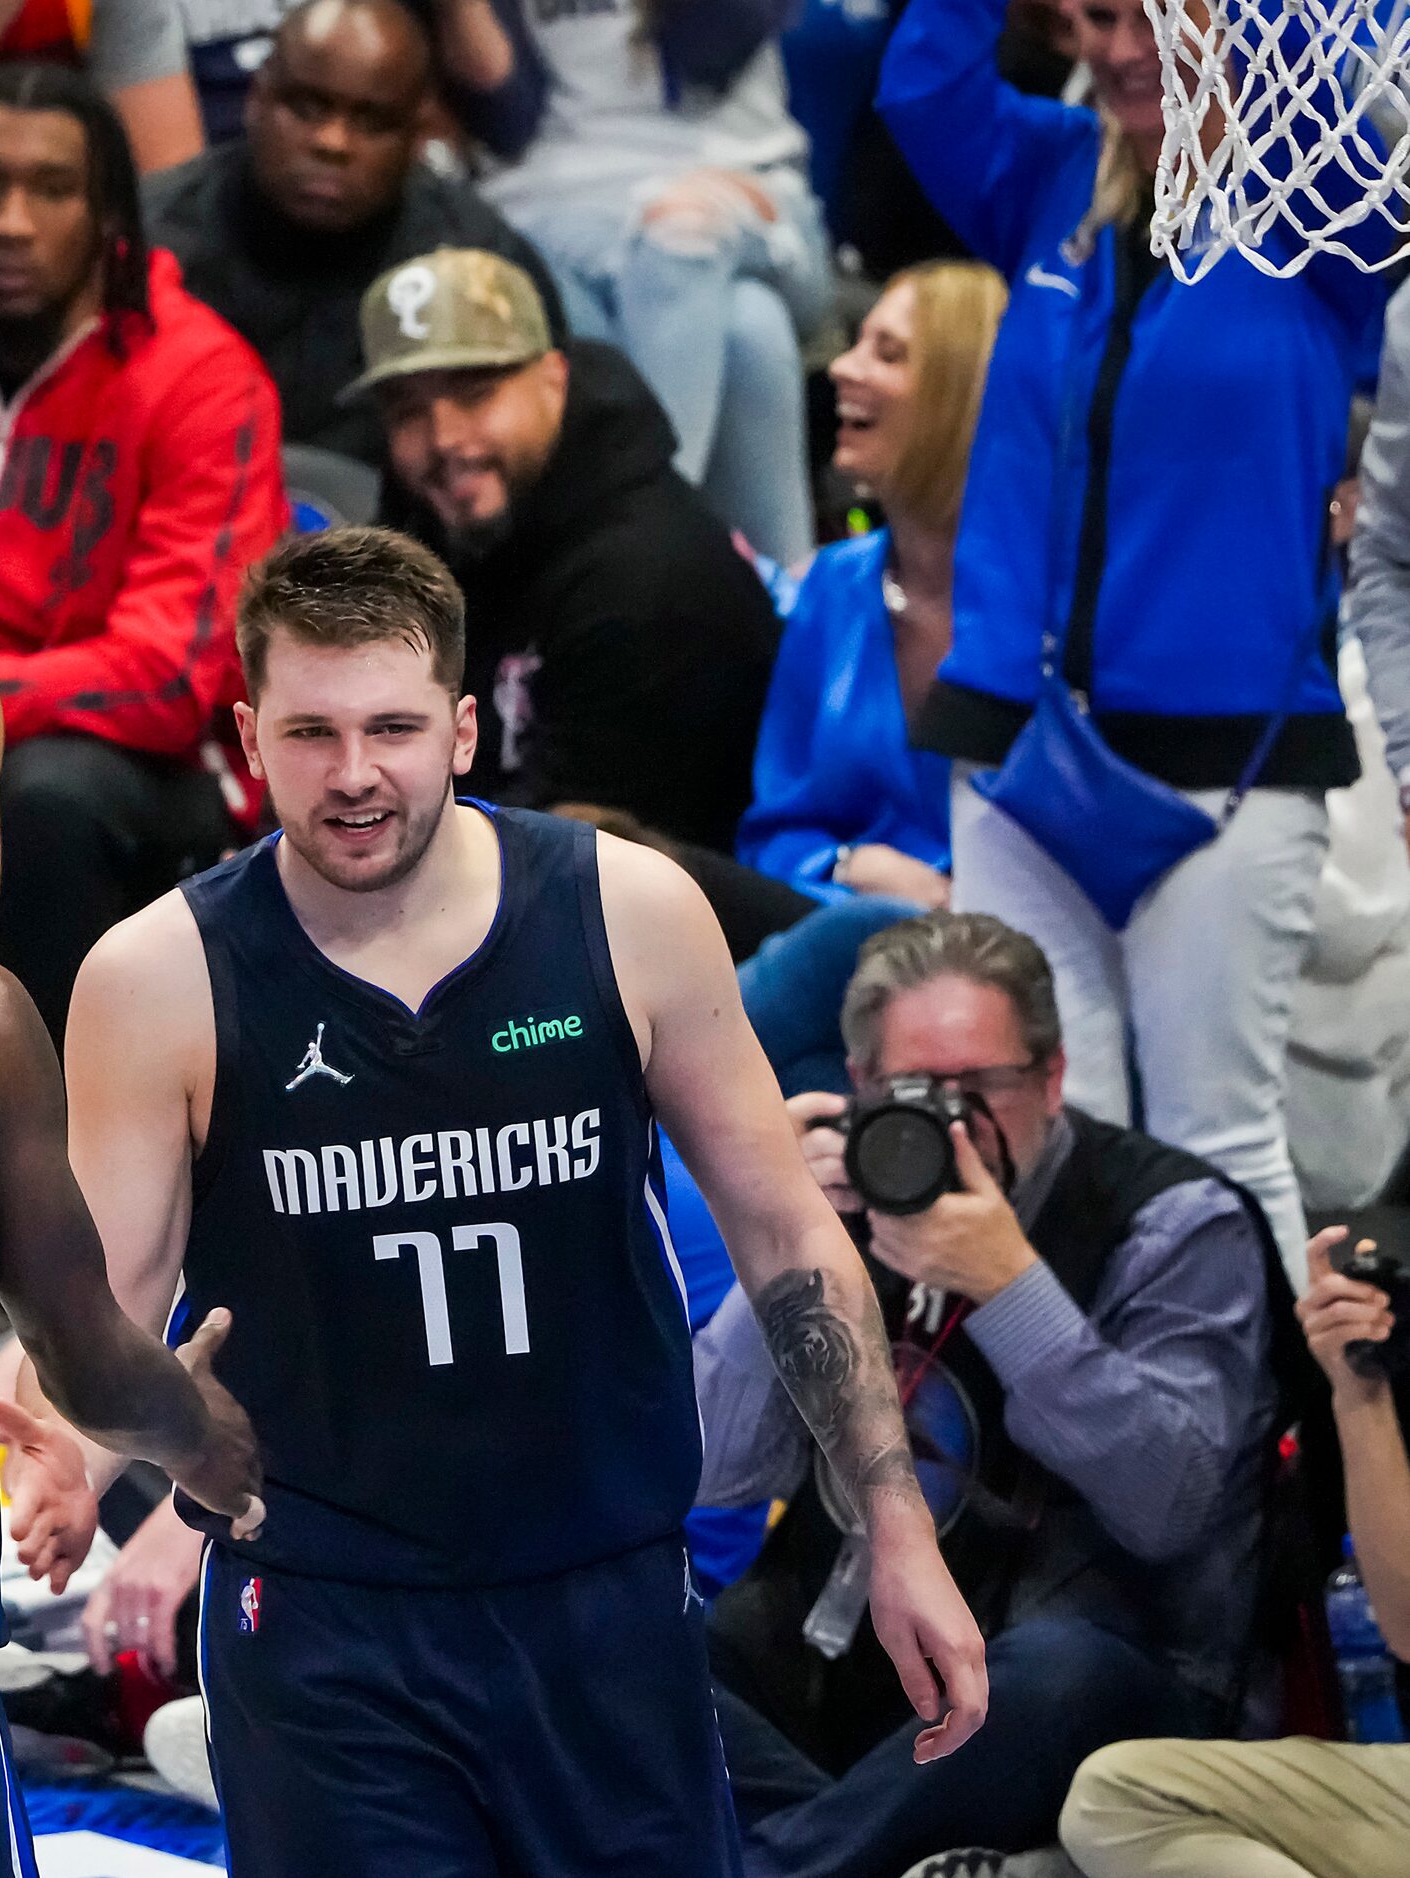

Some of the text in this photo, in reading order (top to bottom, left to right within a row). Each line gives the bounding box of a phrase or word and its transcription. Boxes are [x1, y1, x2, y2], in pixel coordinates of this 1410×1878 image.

[492, 1015, 583, 1053] chime
[262, 1108, 600, 1215] MAVERICKS
[373, 1222, 530, 1366] 77
